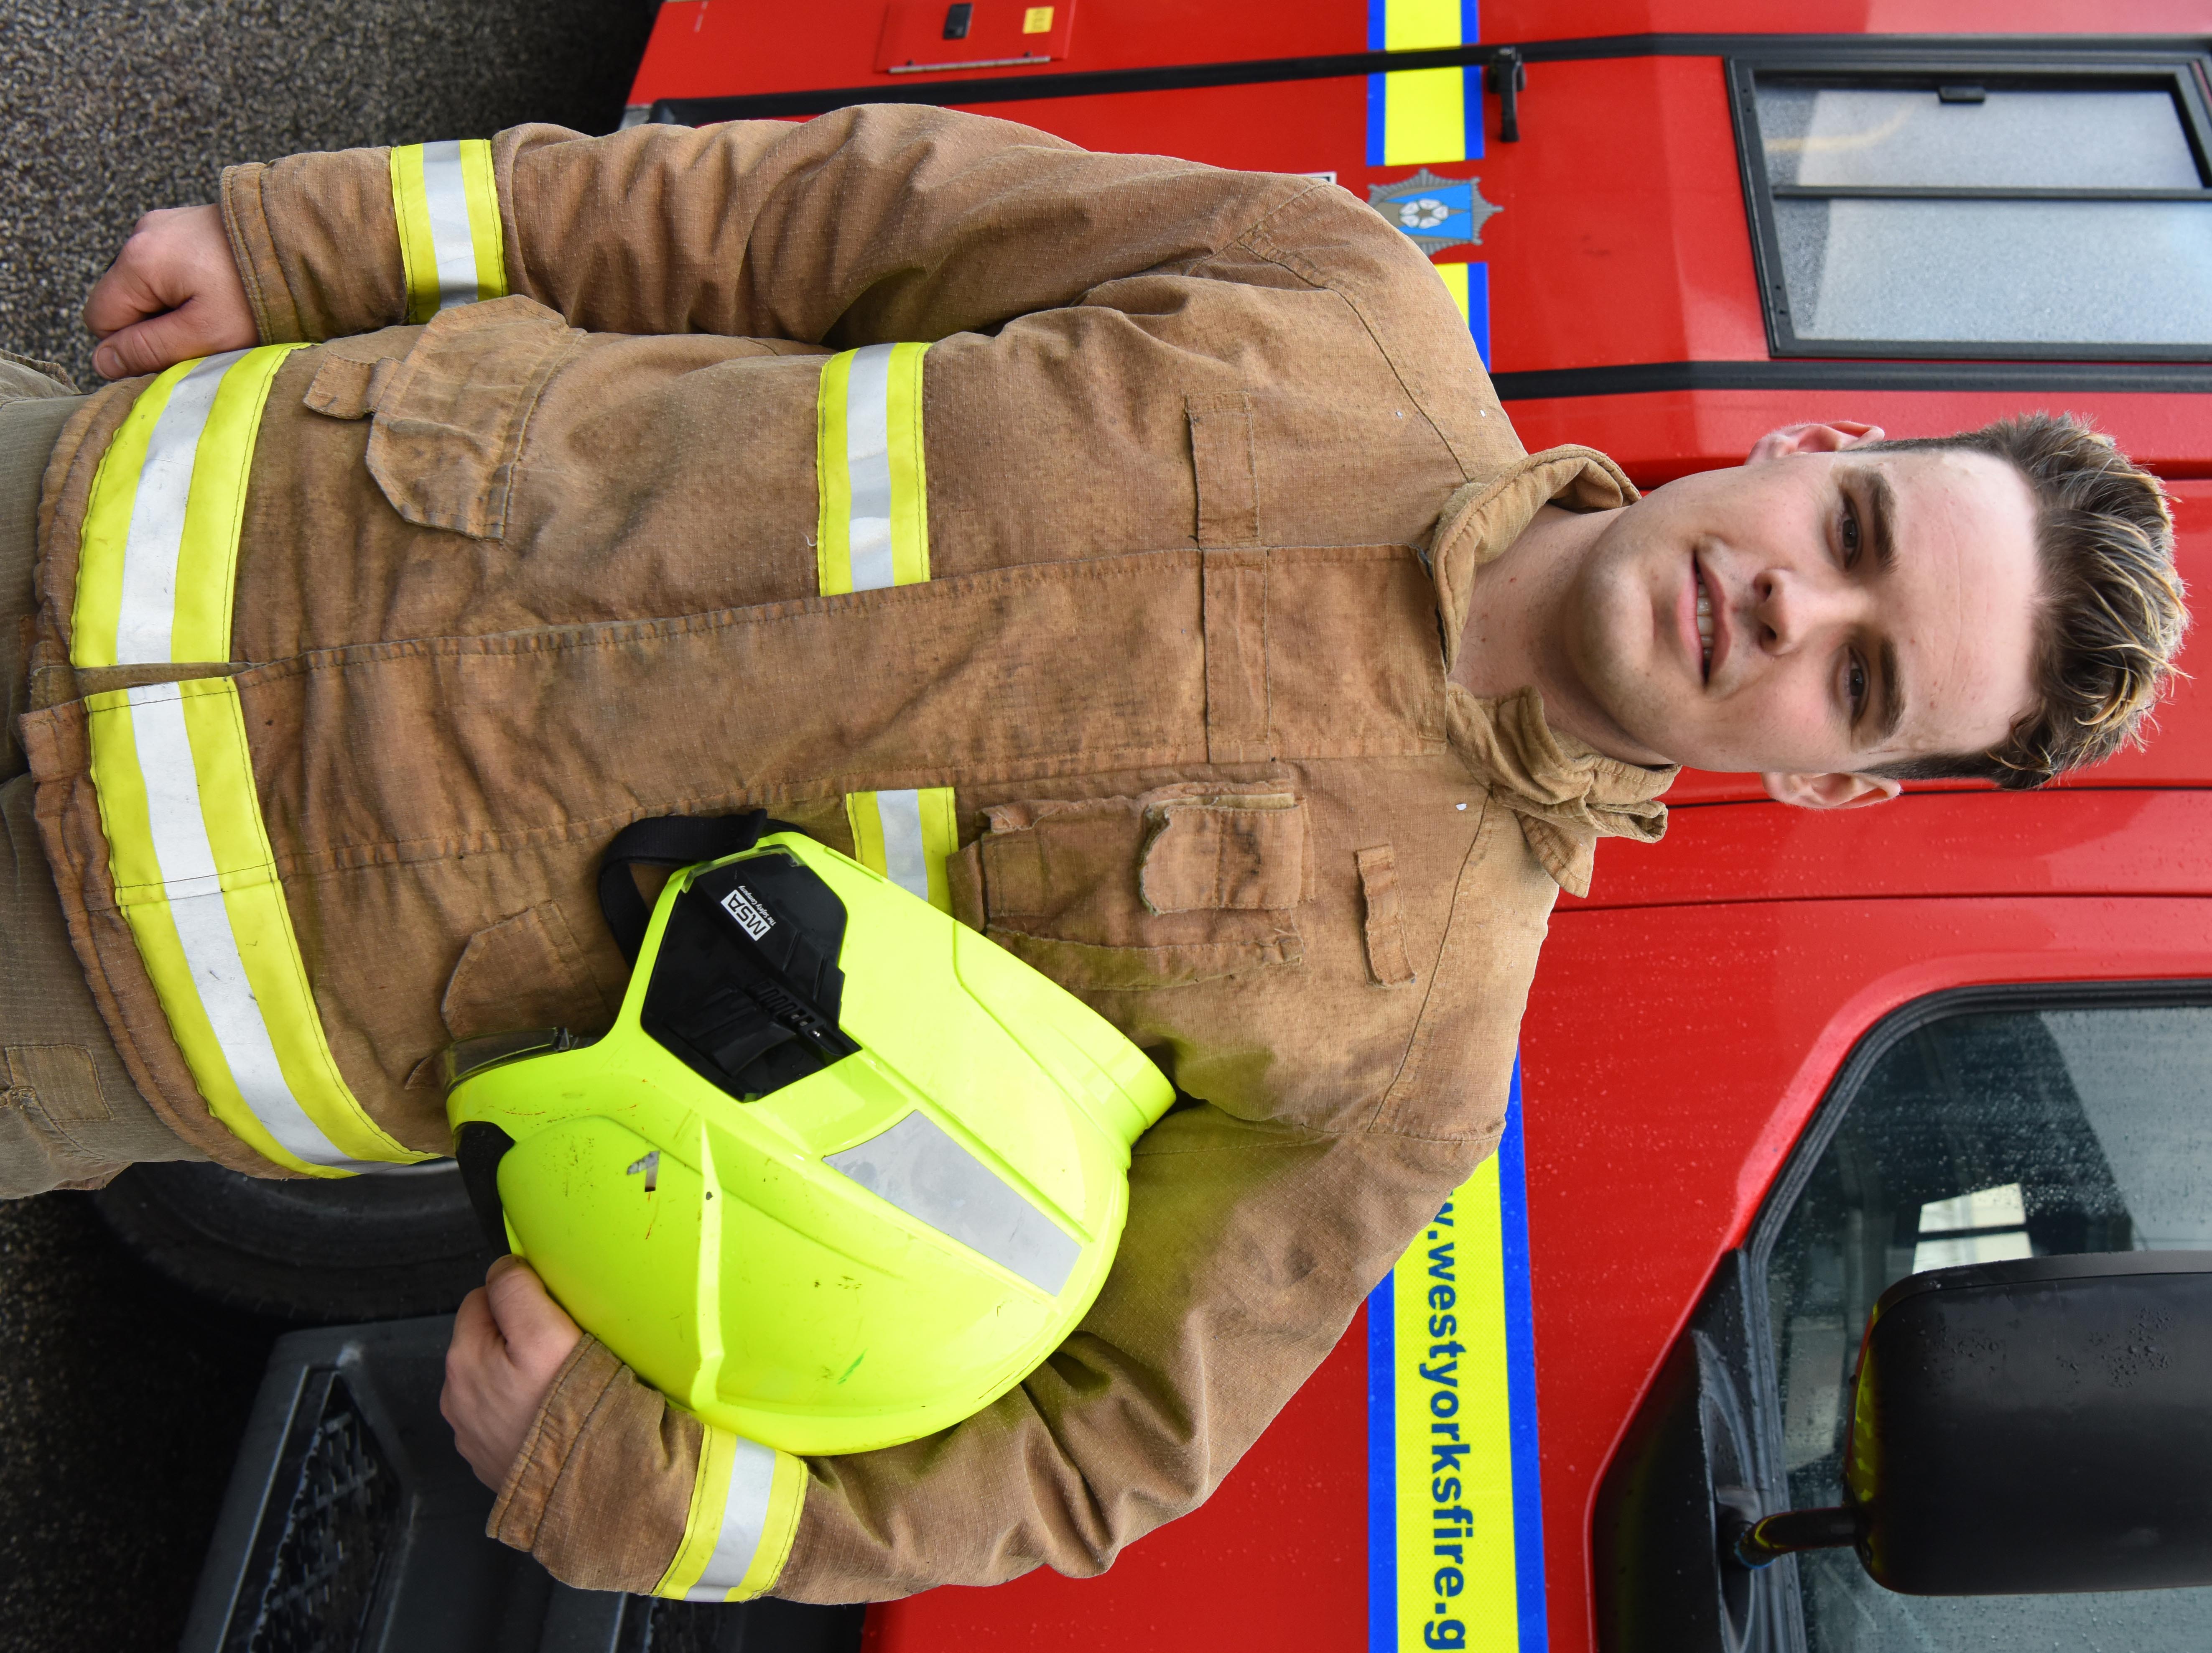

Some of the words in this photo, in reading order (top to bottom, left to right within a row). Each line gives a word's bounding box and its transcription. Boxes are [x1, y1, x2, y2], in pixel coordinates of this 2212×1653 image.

[738, 885, 757, 905] Company
[728, 893, 767, 936] MSA
[756, 904, 770, 918] Safety
[767, 917, 776, 926] The
